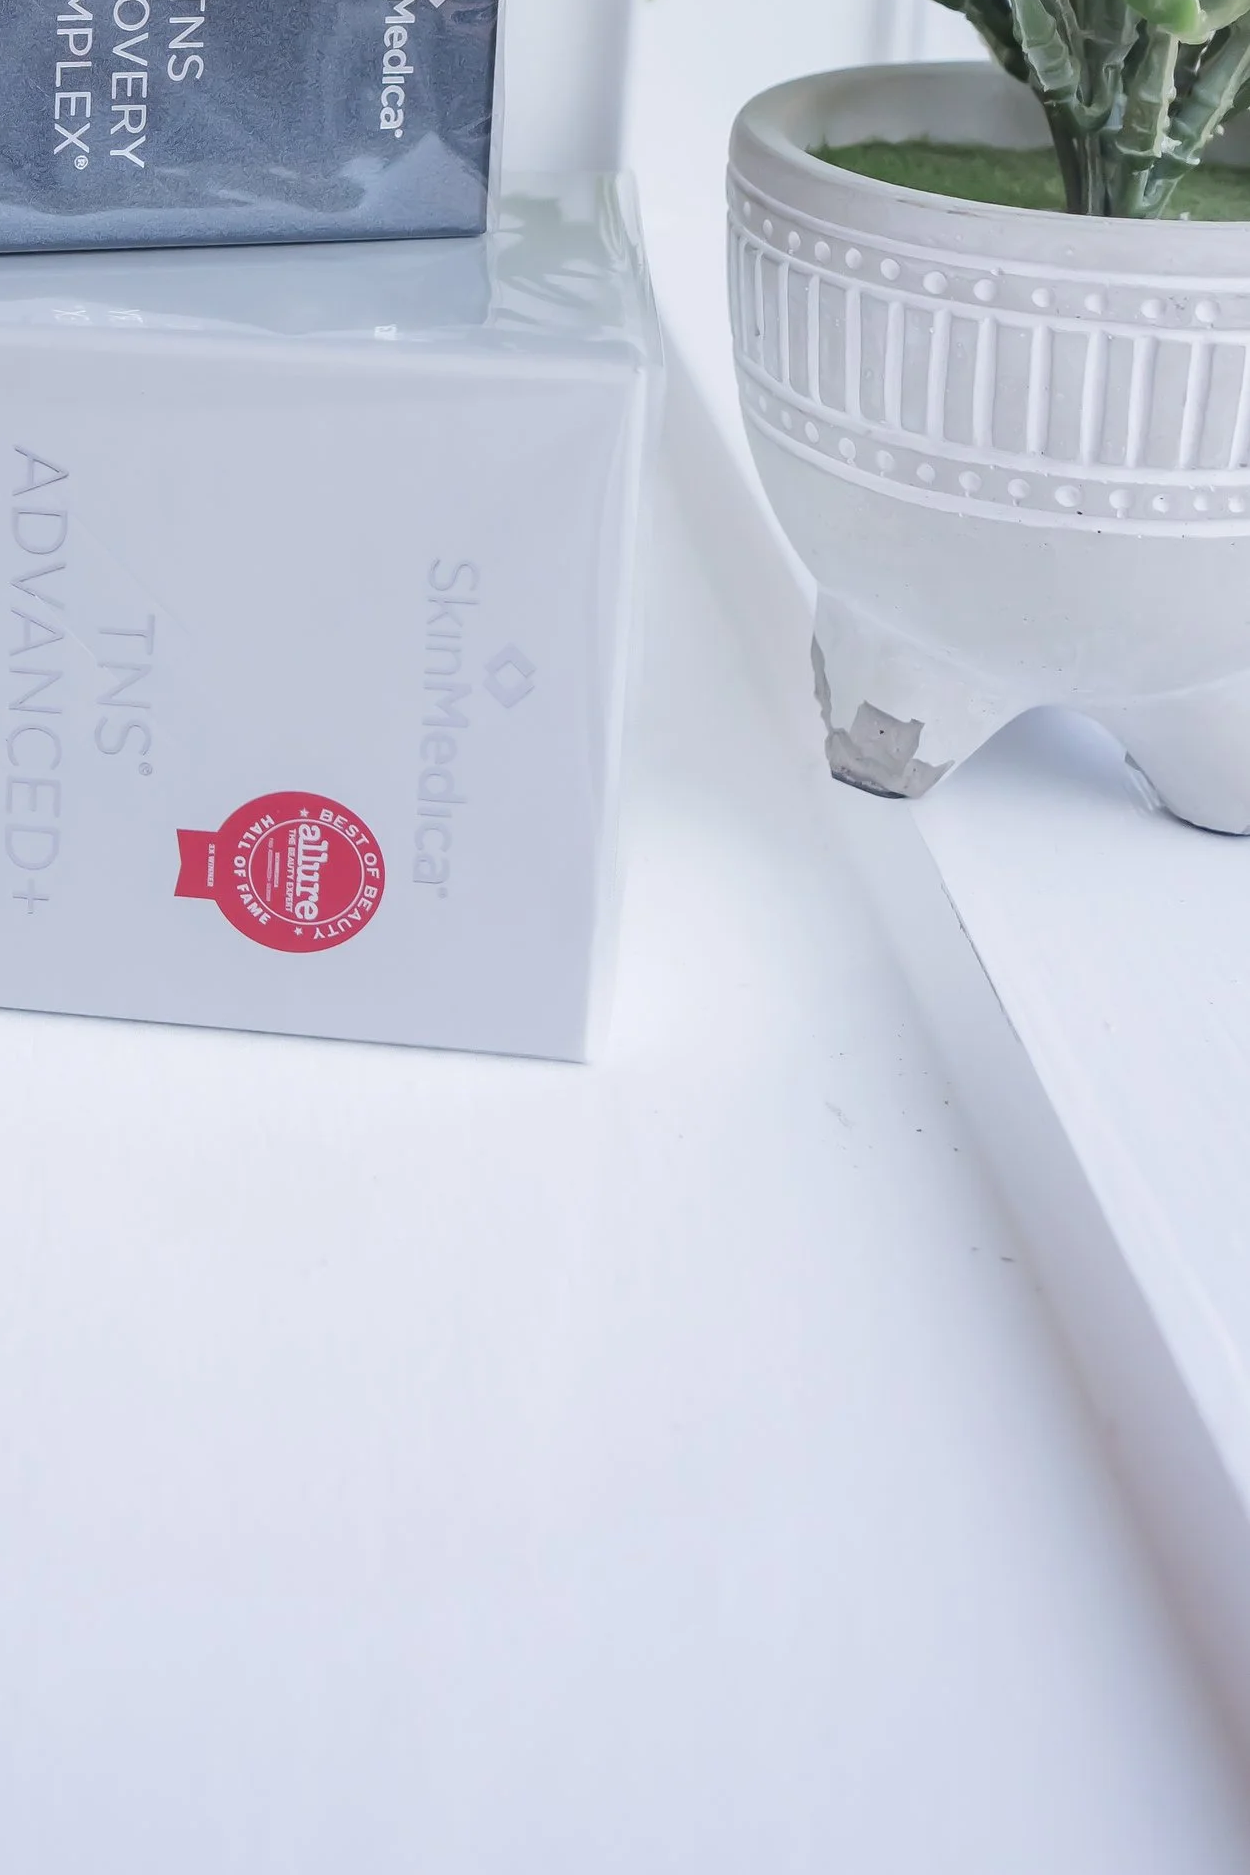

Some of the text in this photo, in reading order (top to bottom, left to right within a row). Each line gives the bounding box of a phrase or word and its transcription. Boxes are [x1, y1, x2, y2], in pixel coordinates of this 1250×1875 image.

[3, 444, 69, 915] ADVANCED+
[207, 855, 215, 887] WINNER
[233, 814, 276, 925] HALL OF FAME
[284, 829, 297, 912] THE BEAUTY EXPERT
[295, 823, 329, 921] allure
[313, 808, 380, 940] BEST OF BEAUTY
